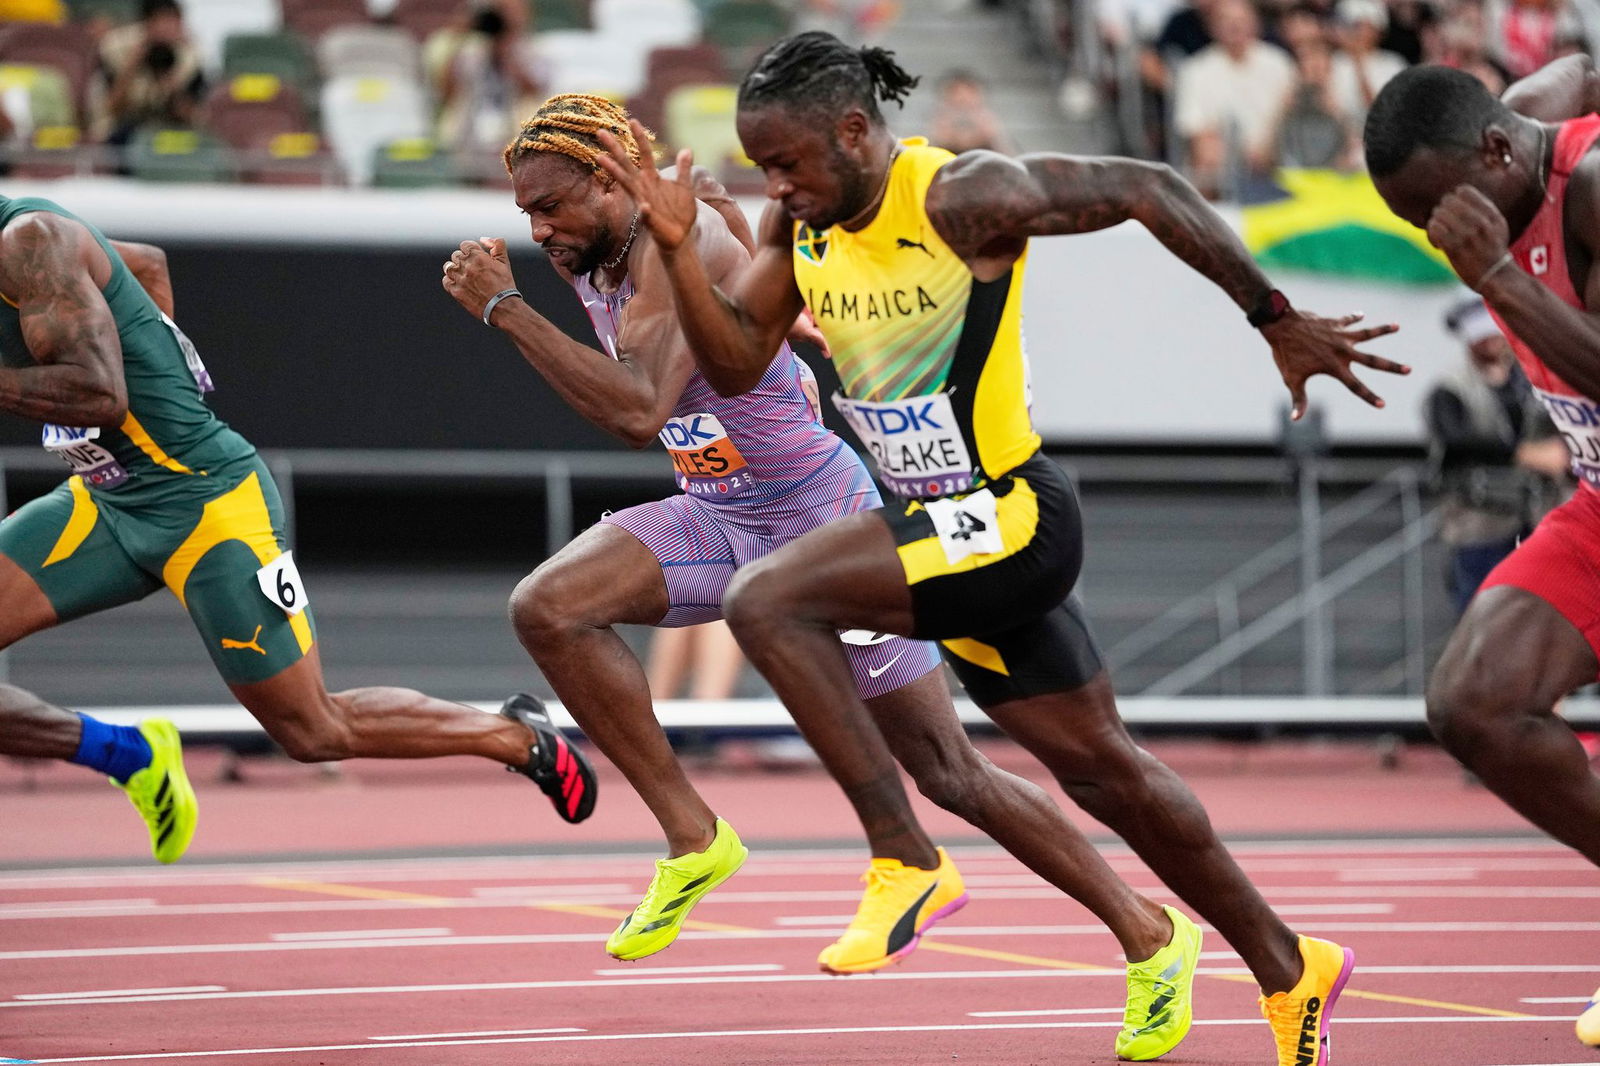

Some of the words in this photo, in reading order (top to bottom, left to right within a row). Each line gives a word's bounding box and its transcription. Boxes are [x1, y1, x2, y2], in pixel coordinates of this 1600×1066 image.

[809, 285, 938, 321] JAMAICA
[854, 402, 942, 435] TDK
[950, 510, 986, 541] 4
[276, 568, 296, 608] 6
